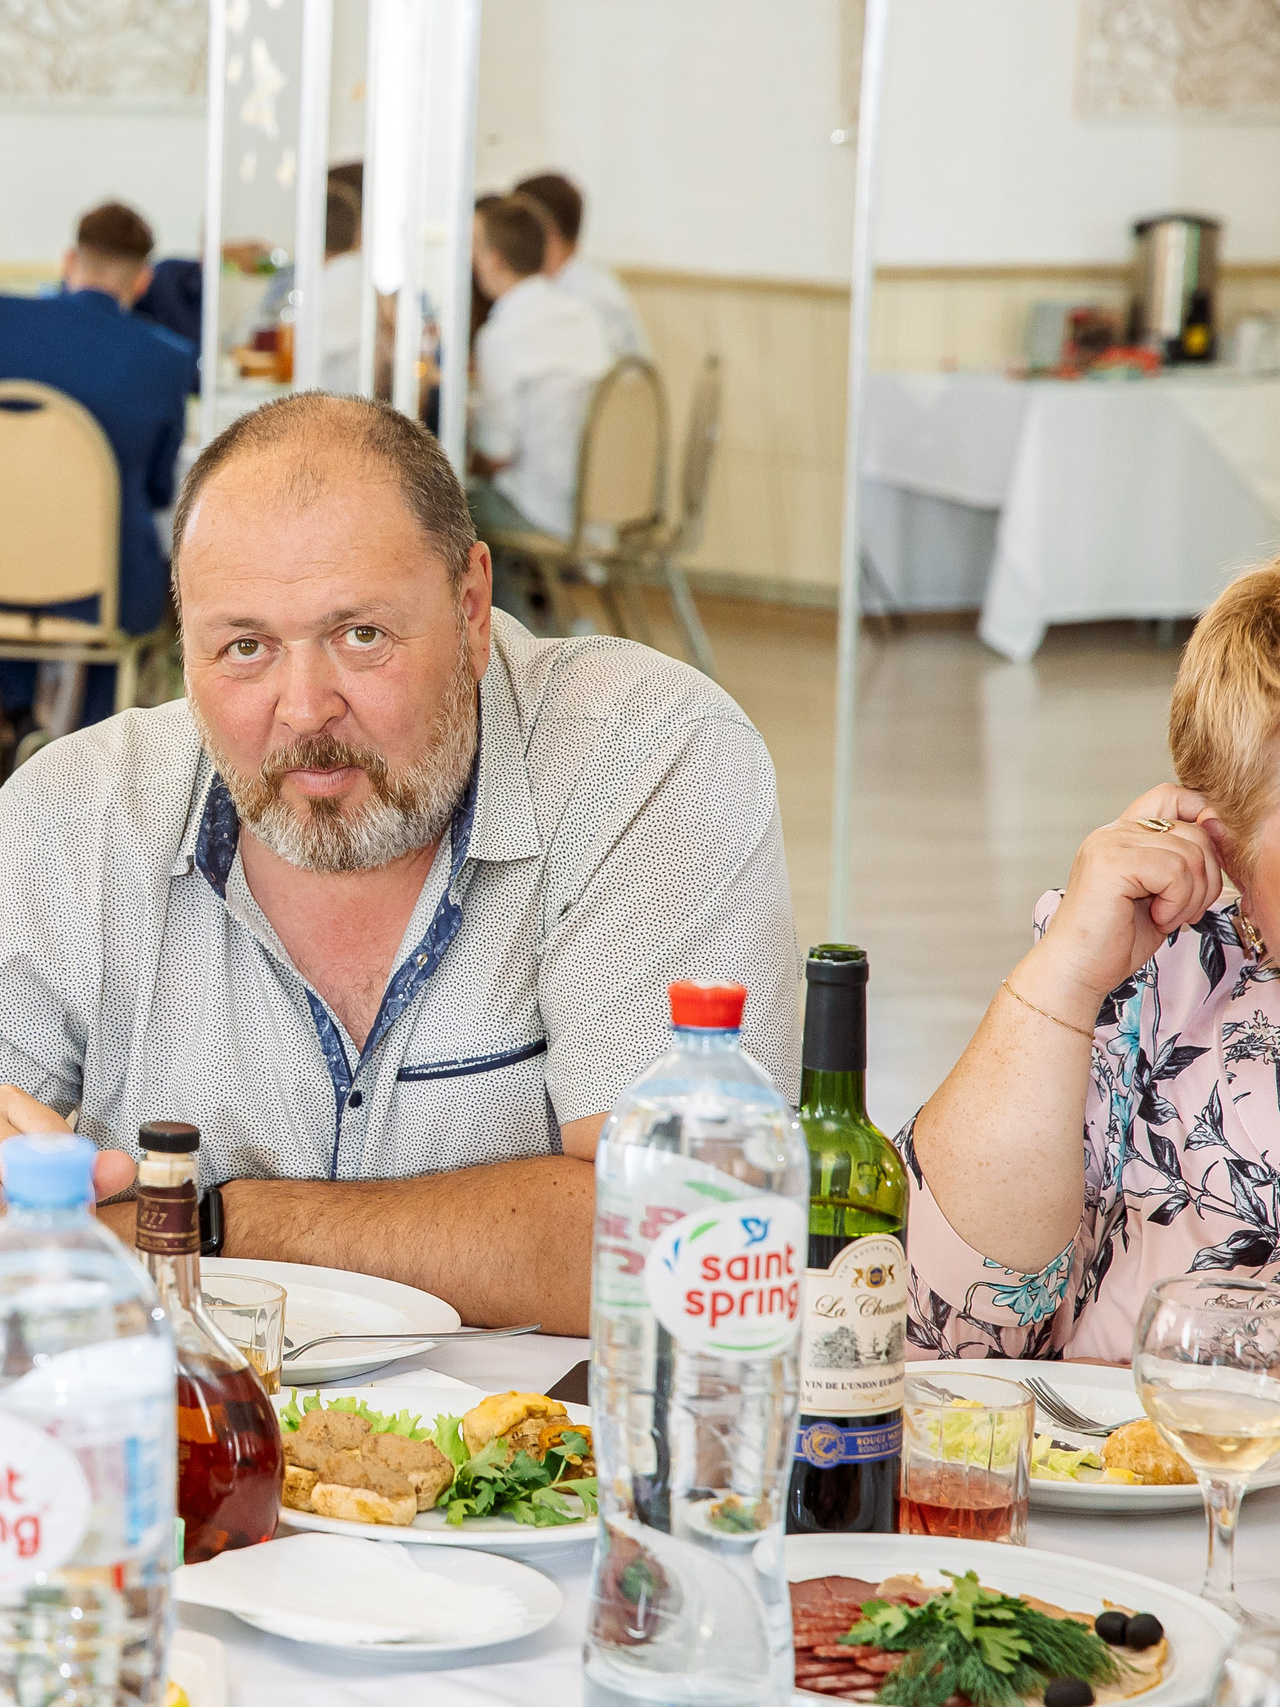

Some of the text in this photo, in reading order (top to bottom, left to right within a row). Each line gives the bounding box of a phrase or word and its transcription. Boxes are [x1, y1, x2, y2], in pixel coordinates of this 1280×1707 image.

[701, 1242, 795, 1281] saint
[685, 1280, 799, 1328] spring
[812, 1294, 847, 1318] La
[804, 1379, 823, 1389] VIN
[825, 1381, 838, 1390] DE
[841, 1380, 877, 1390] L'UNION
